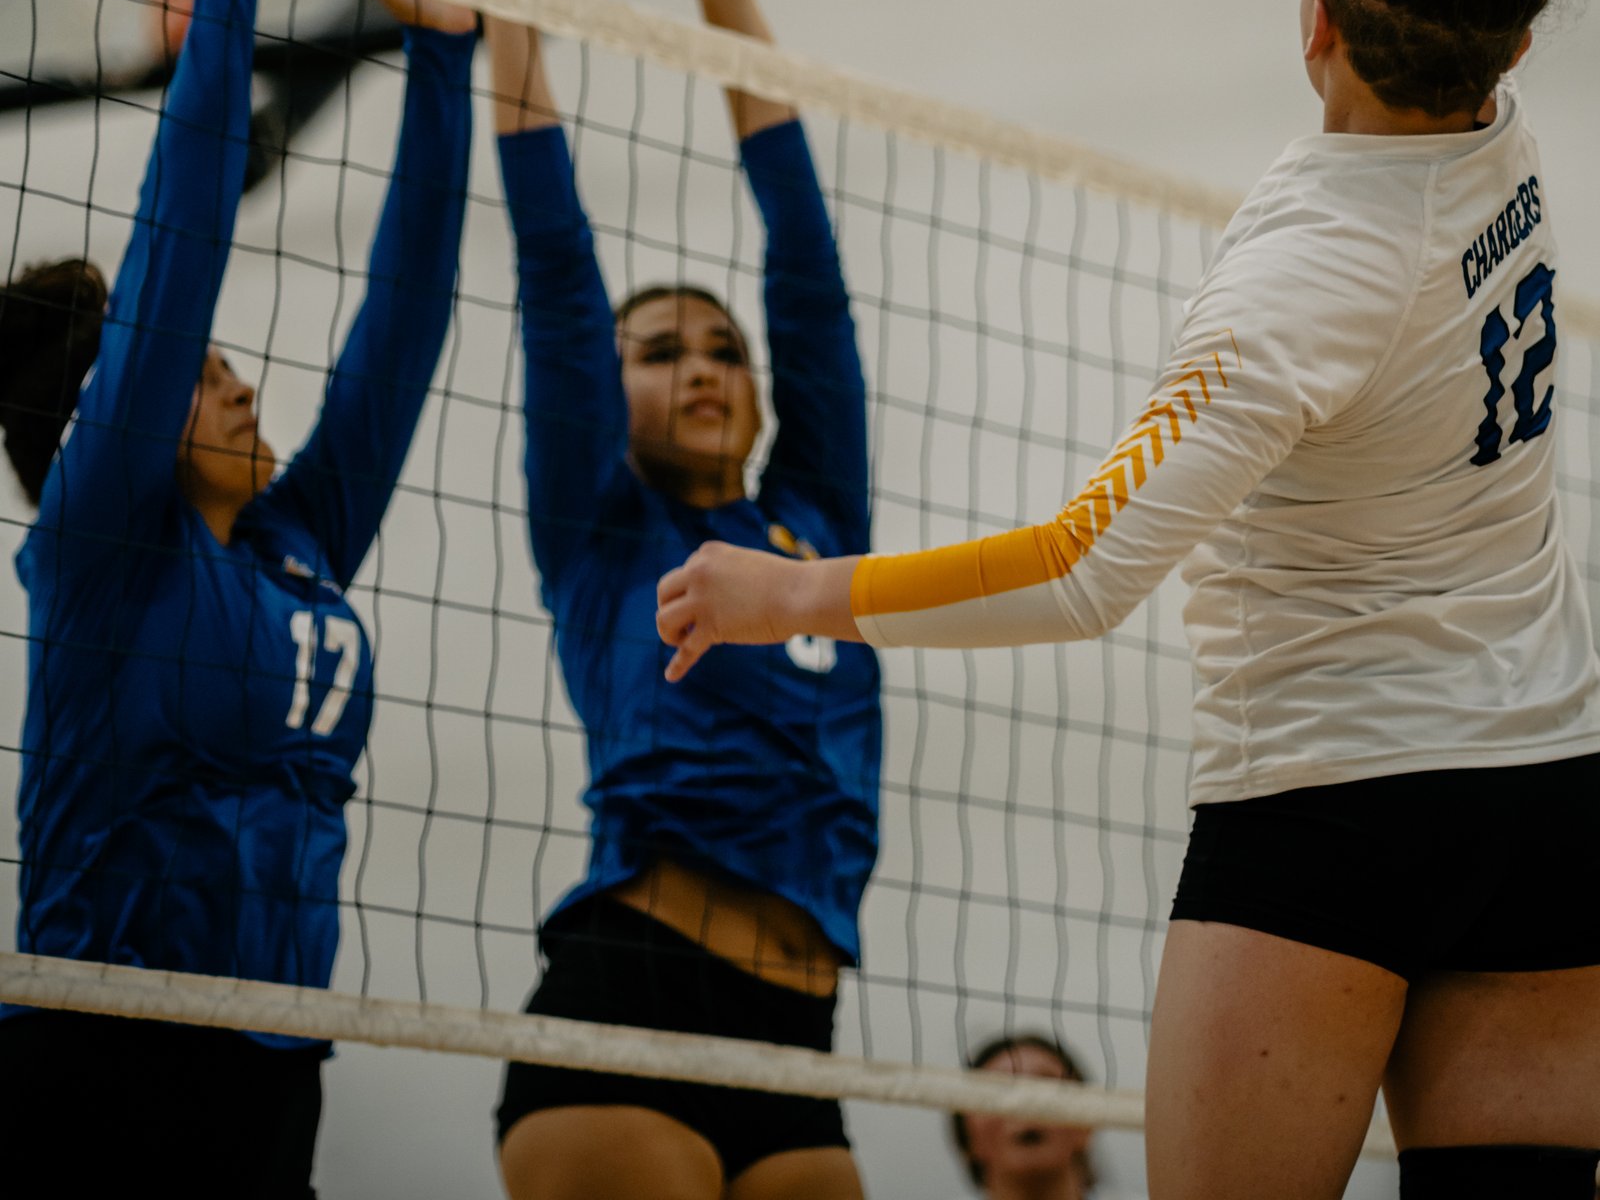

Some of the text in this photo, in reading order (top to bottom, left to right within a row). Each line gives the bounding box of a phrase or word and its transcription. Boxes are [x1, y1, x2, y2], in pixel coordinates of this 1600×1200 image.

[1461, 175, 1541, 299] CHARGERS
[1469, 262, 1556, 467] 12
[285, 610, 361, 737] 17
